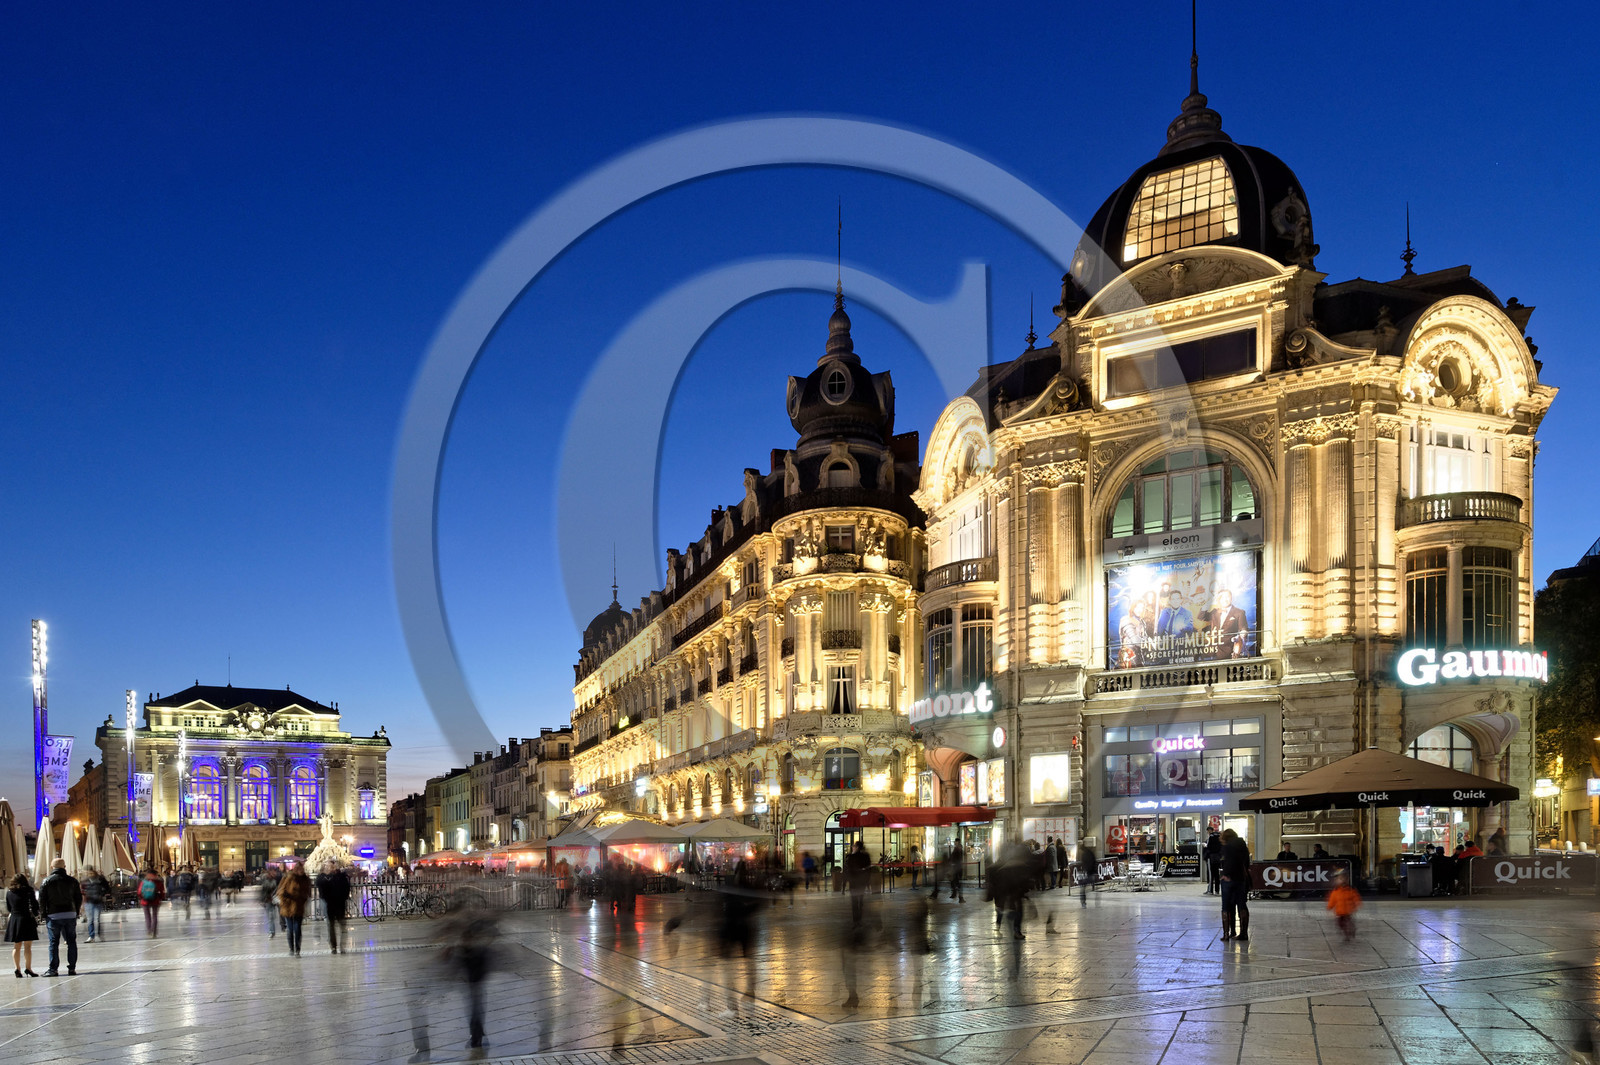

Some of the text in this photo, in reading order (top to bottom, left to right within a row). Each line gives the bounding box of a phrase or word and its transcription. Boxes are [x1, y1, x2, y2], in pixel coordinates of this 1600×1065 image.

[1162, 534, 1200, 546] eleom
[1162, 542, 1200, 551] avocats
[1148, 633, 1177, 652] NUIT
[1175, 637, 1184, 646] AU
[1184, 626, 1225, 648] MUSÉE
[1149, 651, 1175, 660] SECRET
[1180, 645, 1219, 656] PHARAONS
[1151, 734, 1206, 754] Quick
[827, 778, 858, 790] CIC
[1358, 791, 1389, 802] Quick
[1453, 789, 1486, 800] Quick
[1269, 797, 1299, 809] Quick
[1110, 827, 1124, 841] Q
[1097, 861, 1115, 880] Quick
[1262, 864, 1329, 888] Quick
[1494, 860, 1572, 884] Quick
